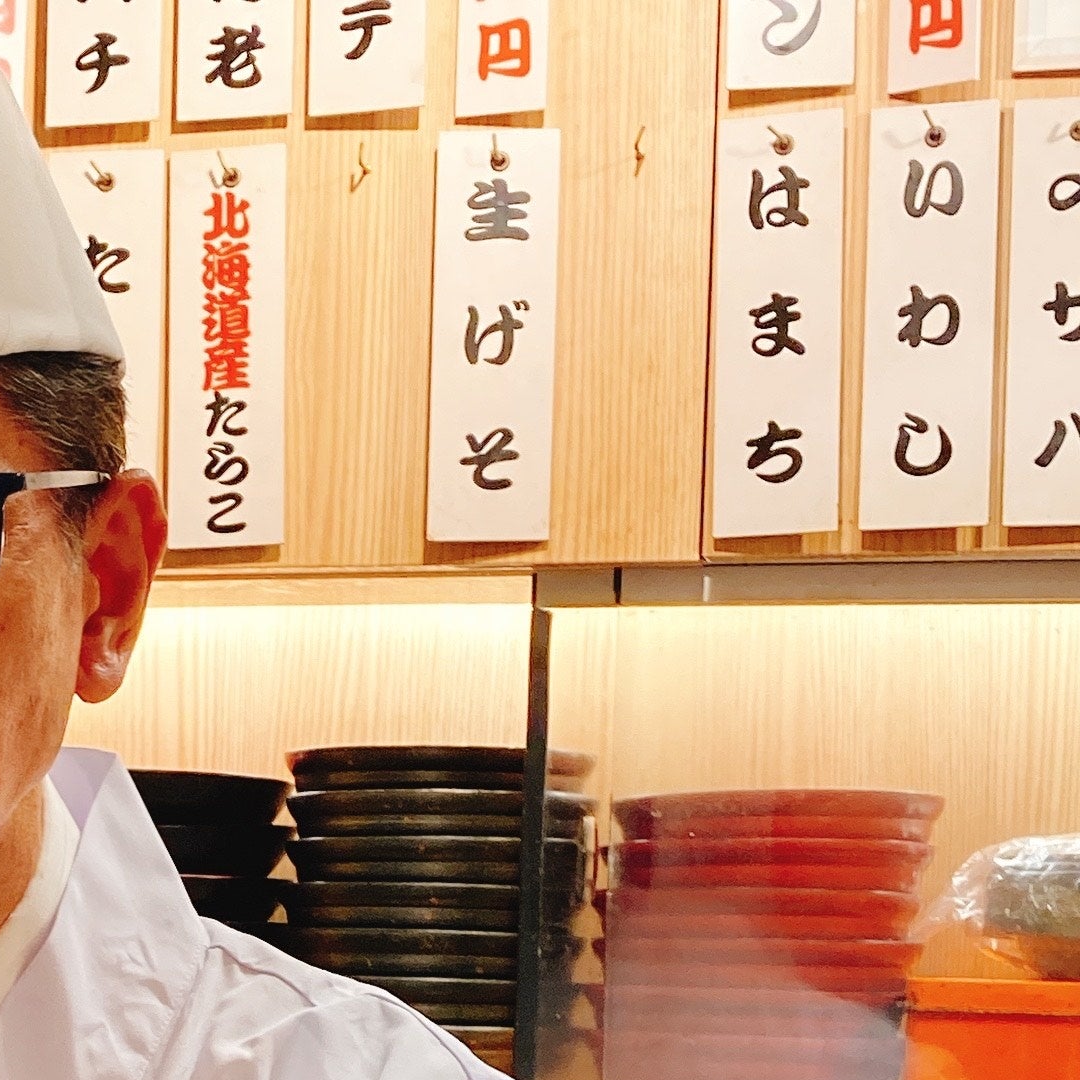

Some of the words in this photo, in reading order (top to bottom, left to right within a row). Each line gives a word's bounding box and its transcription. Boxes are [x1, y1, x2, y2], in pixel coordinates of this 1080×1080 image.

[76, 33, 131, 94] チ
[206, 25, 266, 89] 老
[340, 0, 392, 60] テ
[478, 17, 531, 81] 円
[201, 192, 253, 534] 北海道産たらこ
[460, 178, 531, 491] 生げそ
[747, 165, 811, 484] はまち
[894, 158, 965, 477] いわし
